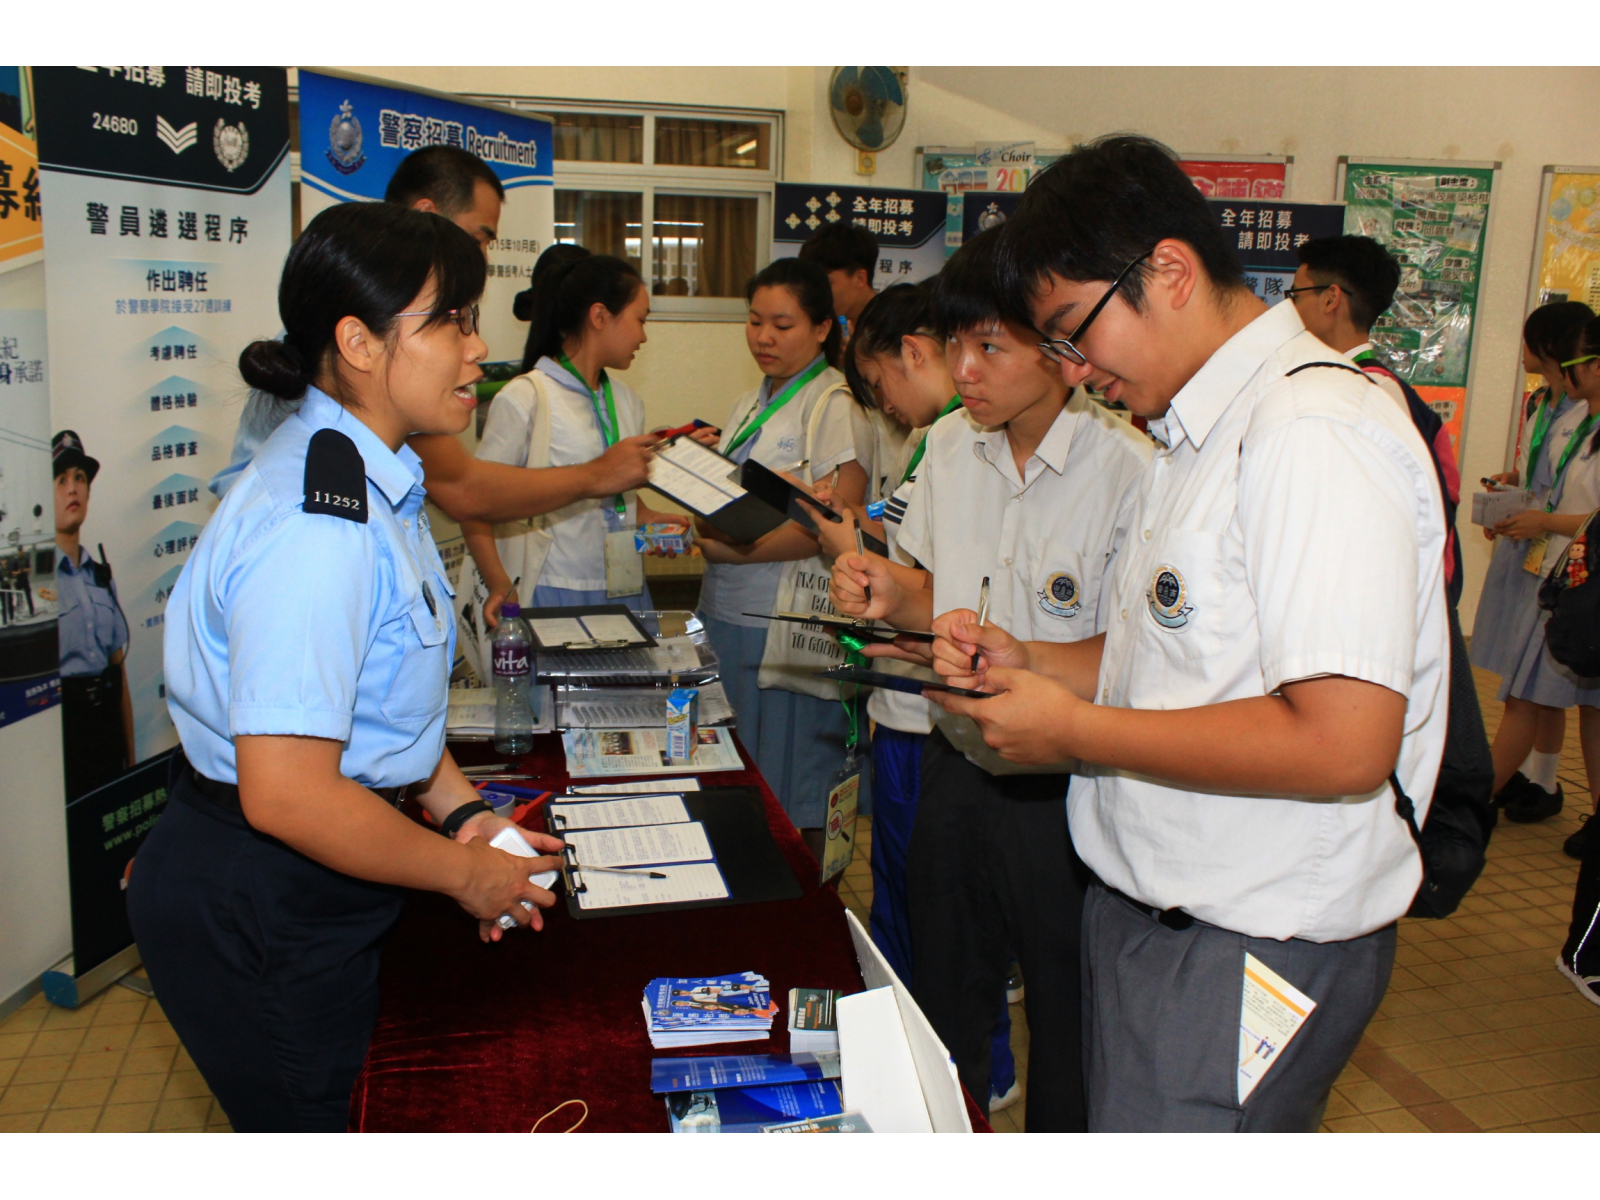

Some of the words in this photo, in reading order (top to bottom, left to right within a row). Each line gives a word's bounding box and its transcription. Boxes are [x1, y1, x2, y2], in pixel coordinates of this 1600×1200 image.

[185, 66, 261, 109] 請即投考
[92, 112, 138, 135] 24680
[467, 127, 537, 167] Recruitment
[1001, 149, 1032, 163] Choir
[852, 196, 914, 215] 全年招募
[86, 202, 248, 244] 警員遴選程序
[1221, 208, 1293, 230] 全年招募
[879, 259, 913, 275] 程序
[146, 269, 208, 292] 作出聘任
[150, 344, 198, 362] 考慮聘任
[150, 392, 198, 412] 體格檢驗
[151, 441, 198, 462] 品格審查
[152, 488, 199, 510] 最後面試
[314, 490, 360, 510] 11252
[792, 632, 805, 650] TO
[494, 650, 529, 670] vita
